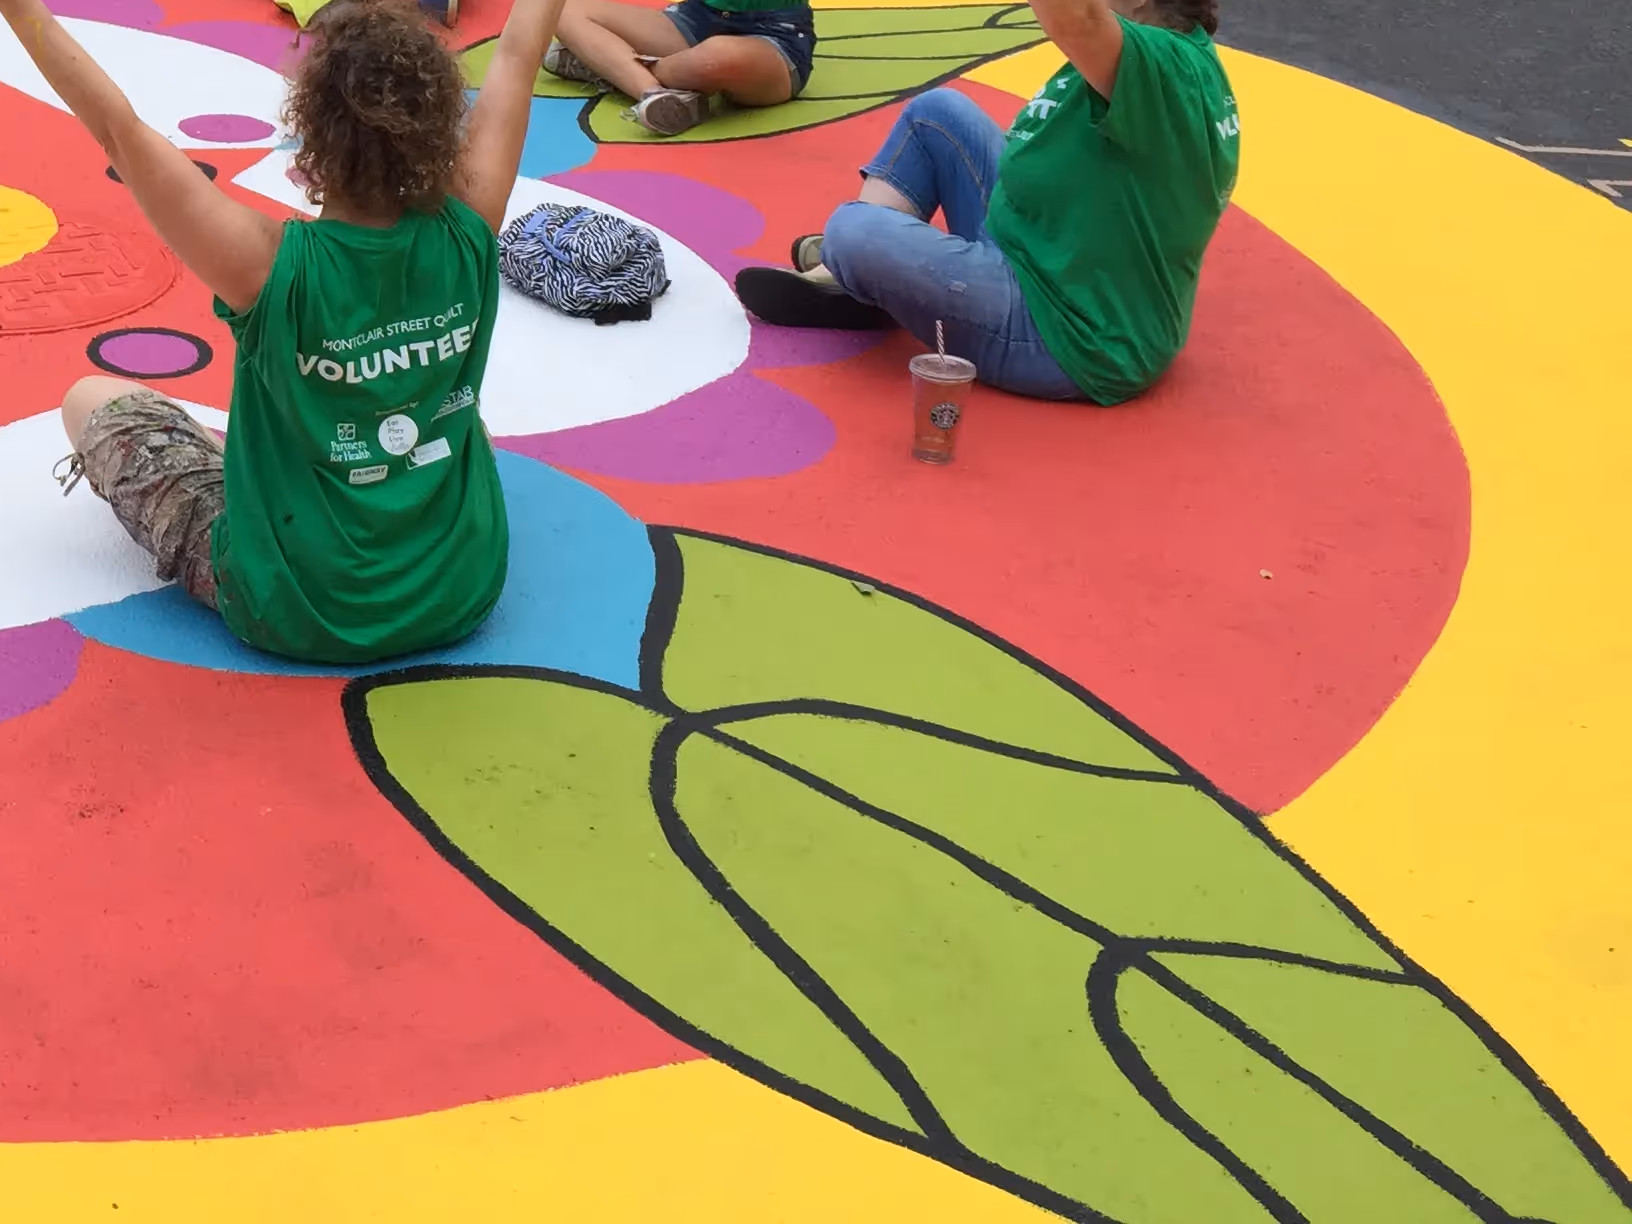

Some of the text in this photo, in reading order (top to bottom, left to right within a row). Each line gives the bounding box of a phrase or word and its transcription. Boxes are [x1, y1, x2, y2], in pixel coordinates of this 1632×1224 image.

[322, 303, 464, 352] MONTCLAIR STREET QUILT
